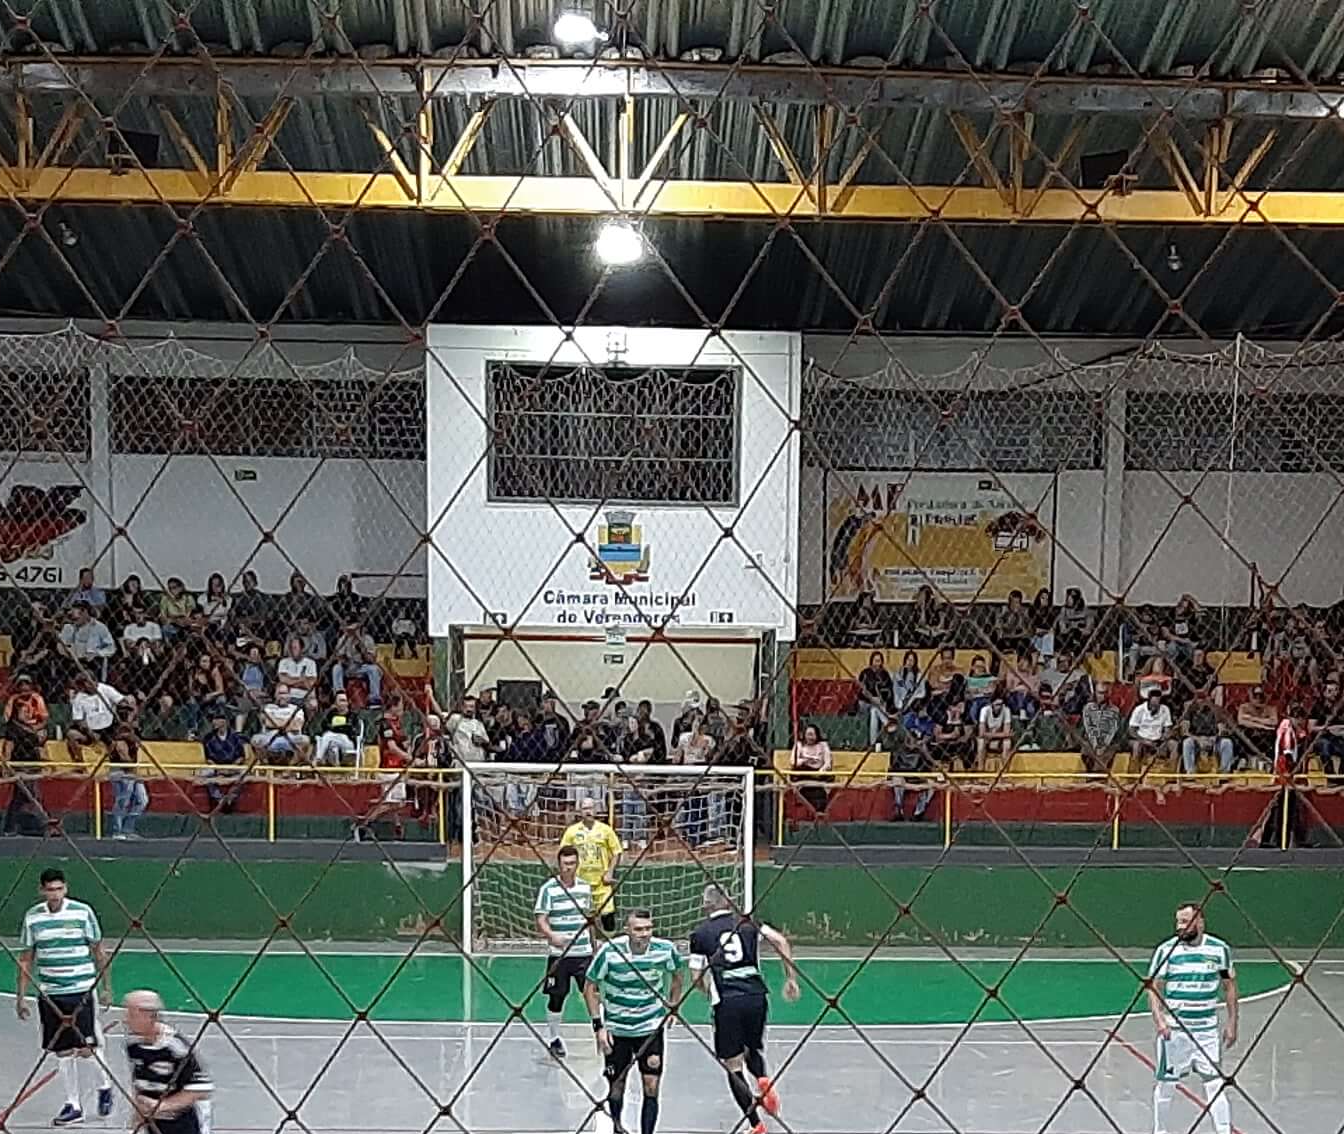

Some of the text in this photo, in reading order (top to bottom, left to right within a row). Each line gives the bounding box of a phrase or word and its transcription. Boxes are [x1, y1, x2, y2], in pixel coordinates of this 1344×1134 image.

[543, 589, 696, 609] Câmara Municipal
[556, 609, 577, 624] de
[718, 930, 744, 964] 9
